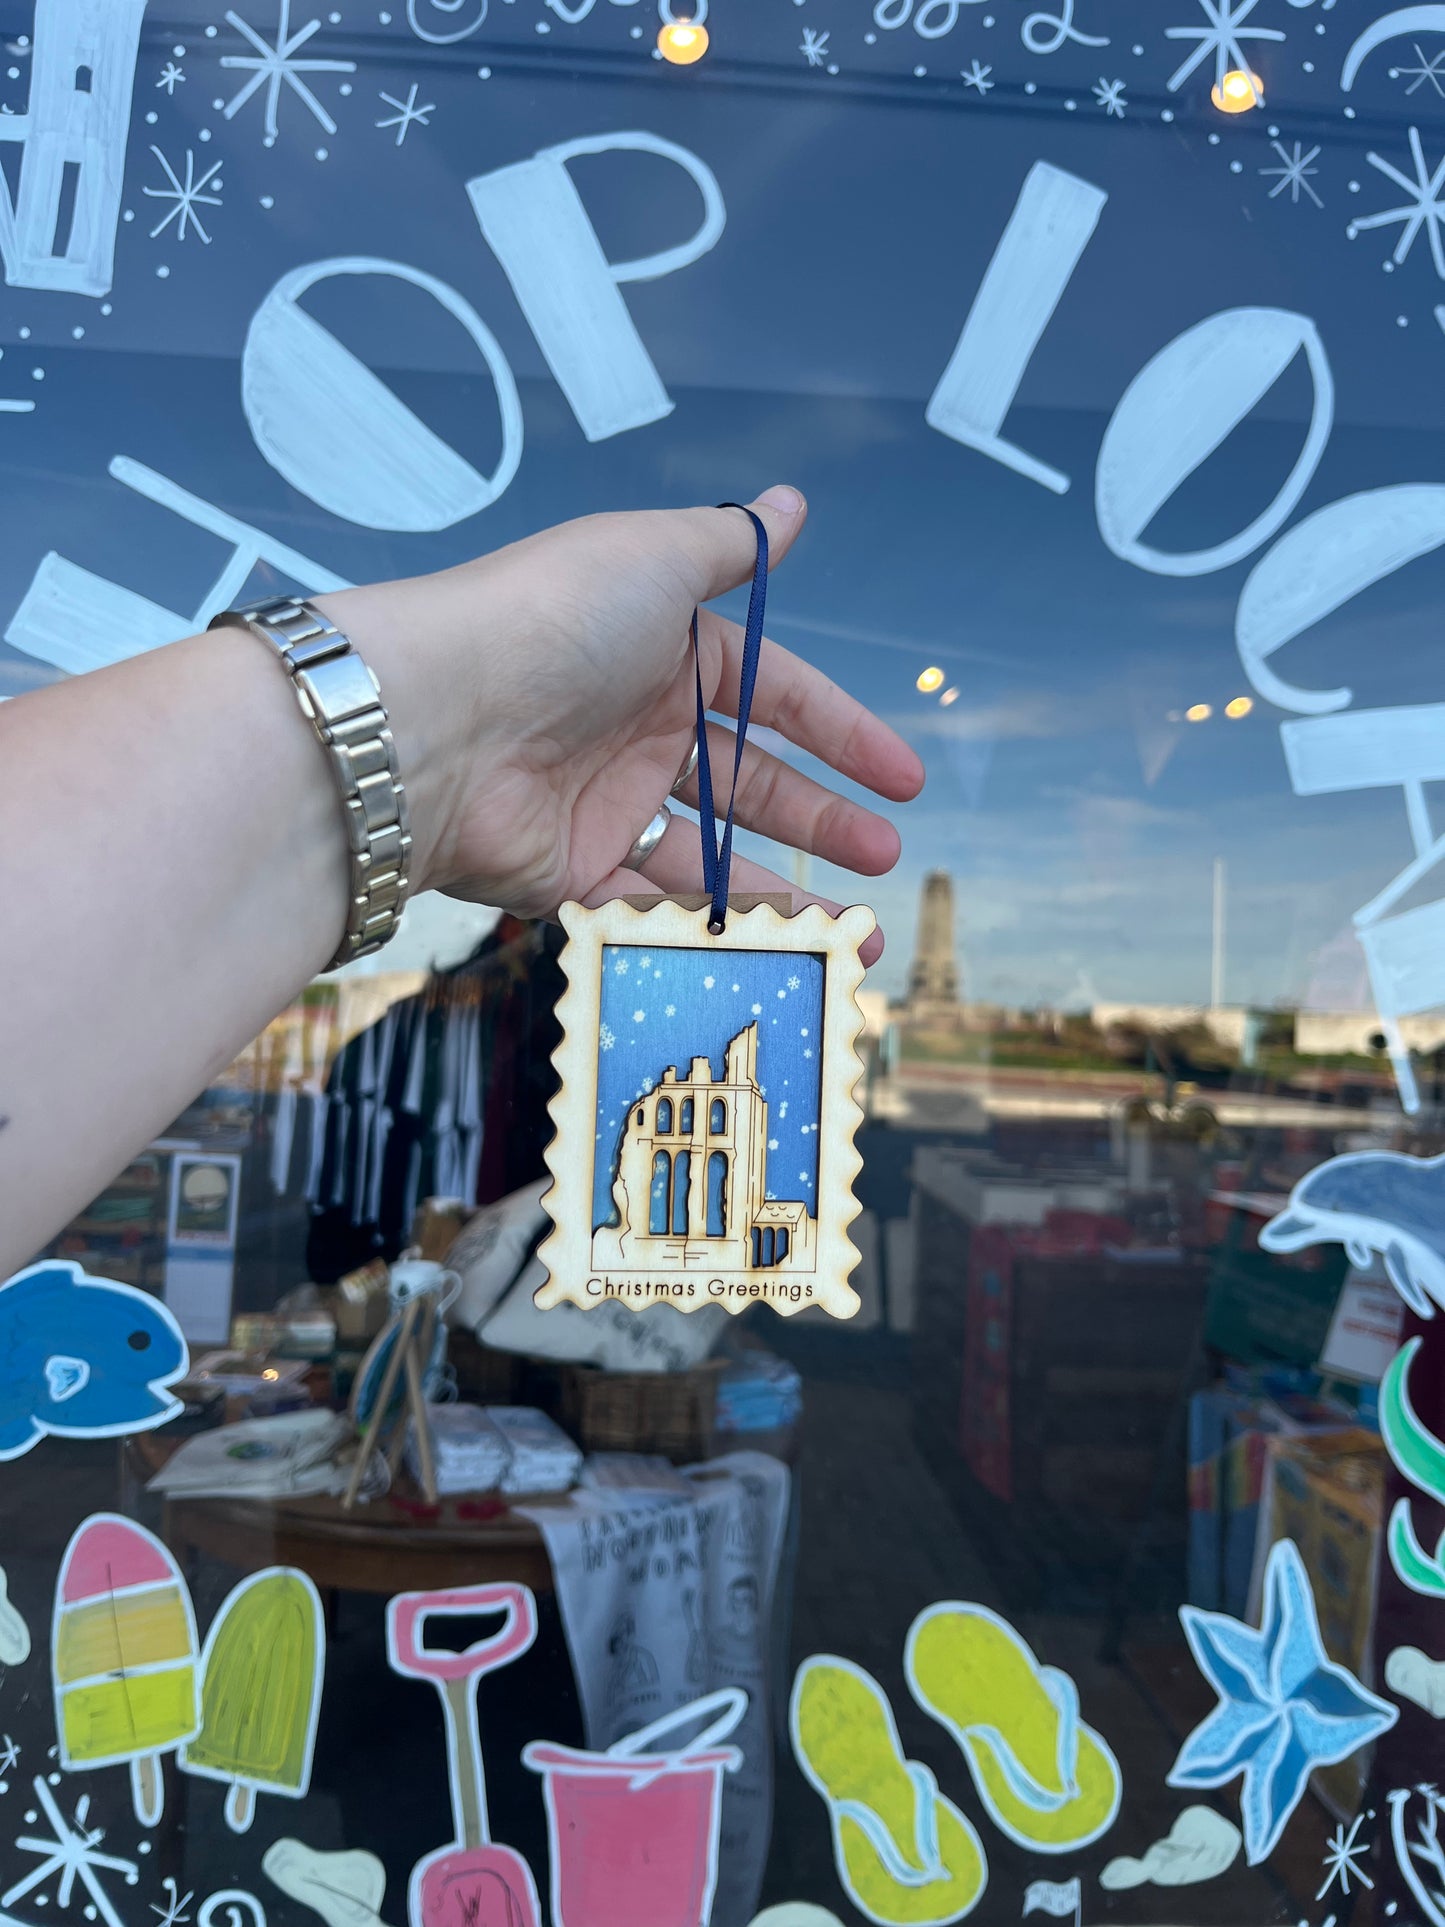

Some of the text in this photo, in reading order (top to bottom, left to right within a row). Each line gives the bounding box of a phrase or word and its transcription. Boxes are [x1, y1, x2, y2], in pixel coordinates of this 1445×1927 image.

[3, 130, 726, 676] HOP
[586, 1276, 813, 1302] Christmas Greetings
